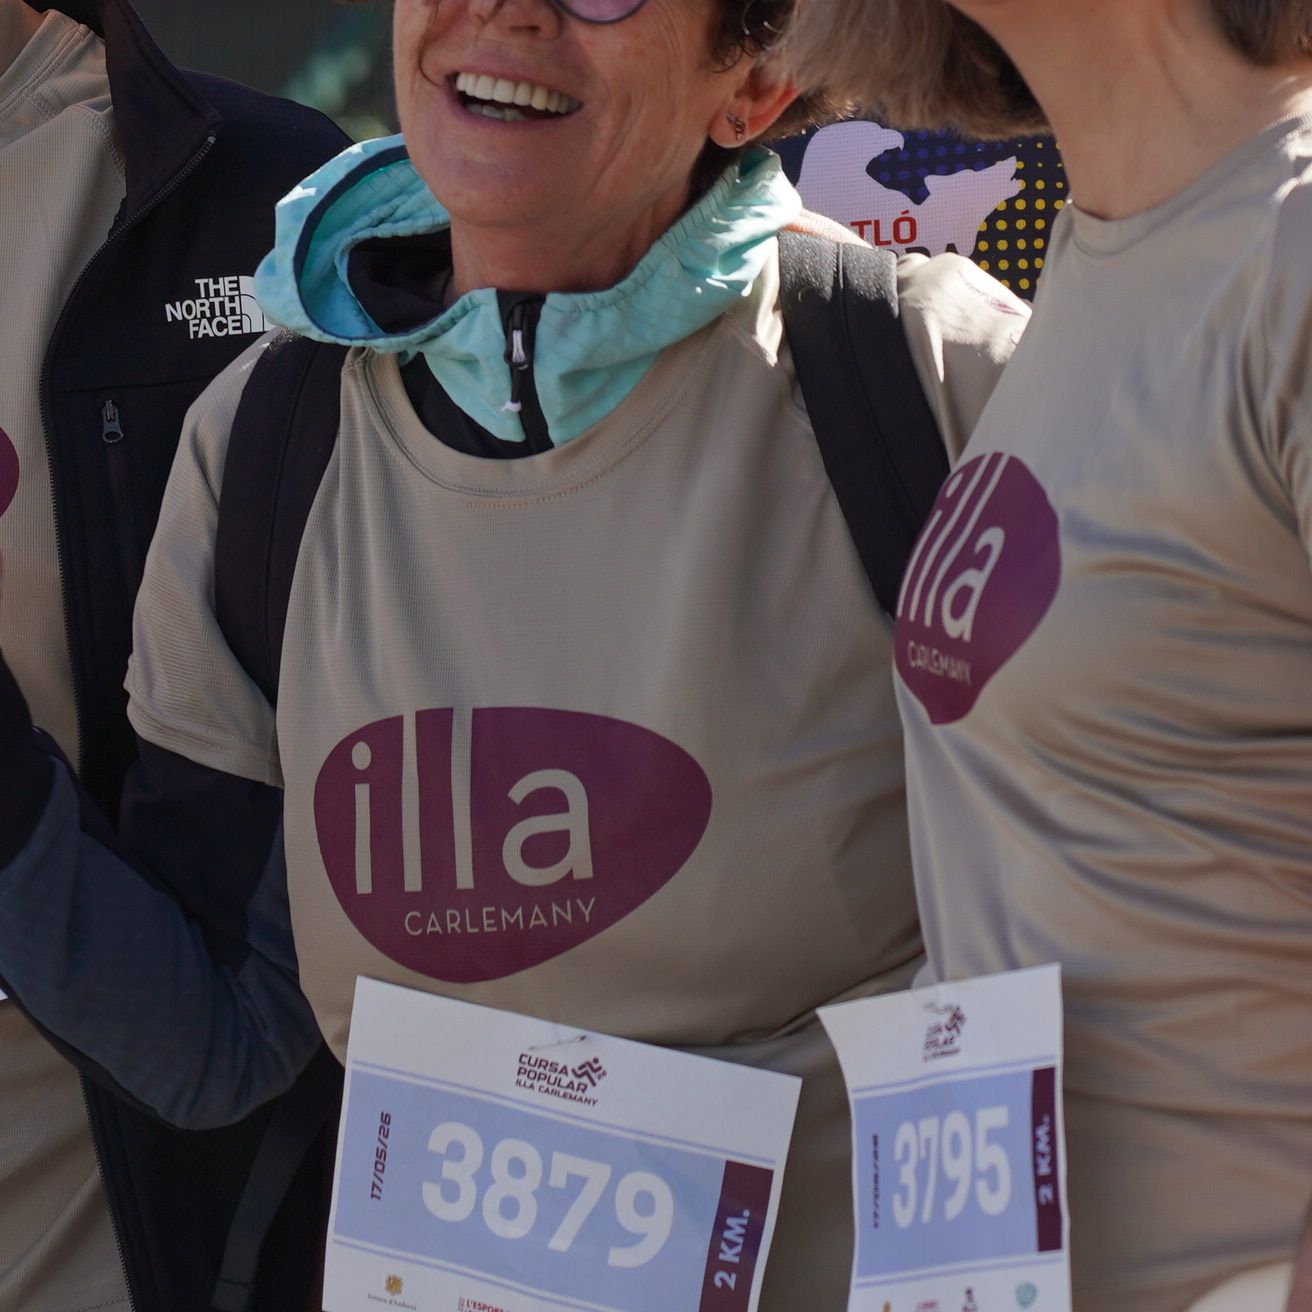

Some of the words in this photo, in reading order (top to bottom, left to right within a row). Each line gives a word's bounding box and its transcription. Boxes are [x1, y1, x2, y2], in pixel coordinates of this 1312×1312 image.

[849, 209, 917, 246] TLÓ
[194, 276, 239, 298] THE
[164, 295, 241, 322] NORTH
[189, 315, 242, 339] FACE
[896, 453, 1009, 642] illa
[351, 707, 593, 894] illa
[404, 897, 596, 936] CARLEMANY
[517, 1066, 588, 1094] POPULAR
[518, 1053, 569, 1076] CURSA
[515, 1079, 535, 1090] ILLA
[538, 1086, 599, 1106] CARLEMANY
[370, 1111, 392, 1201] 17/05/26
[892, 1104, 1011, 1230] 3795
[422, 1121, 674, 1268] 3879
[718, 1208, 751, 1265] KM.
[714, 1272, 737, 1292] 2
